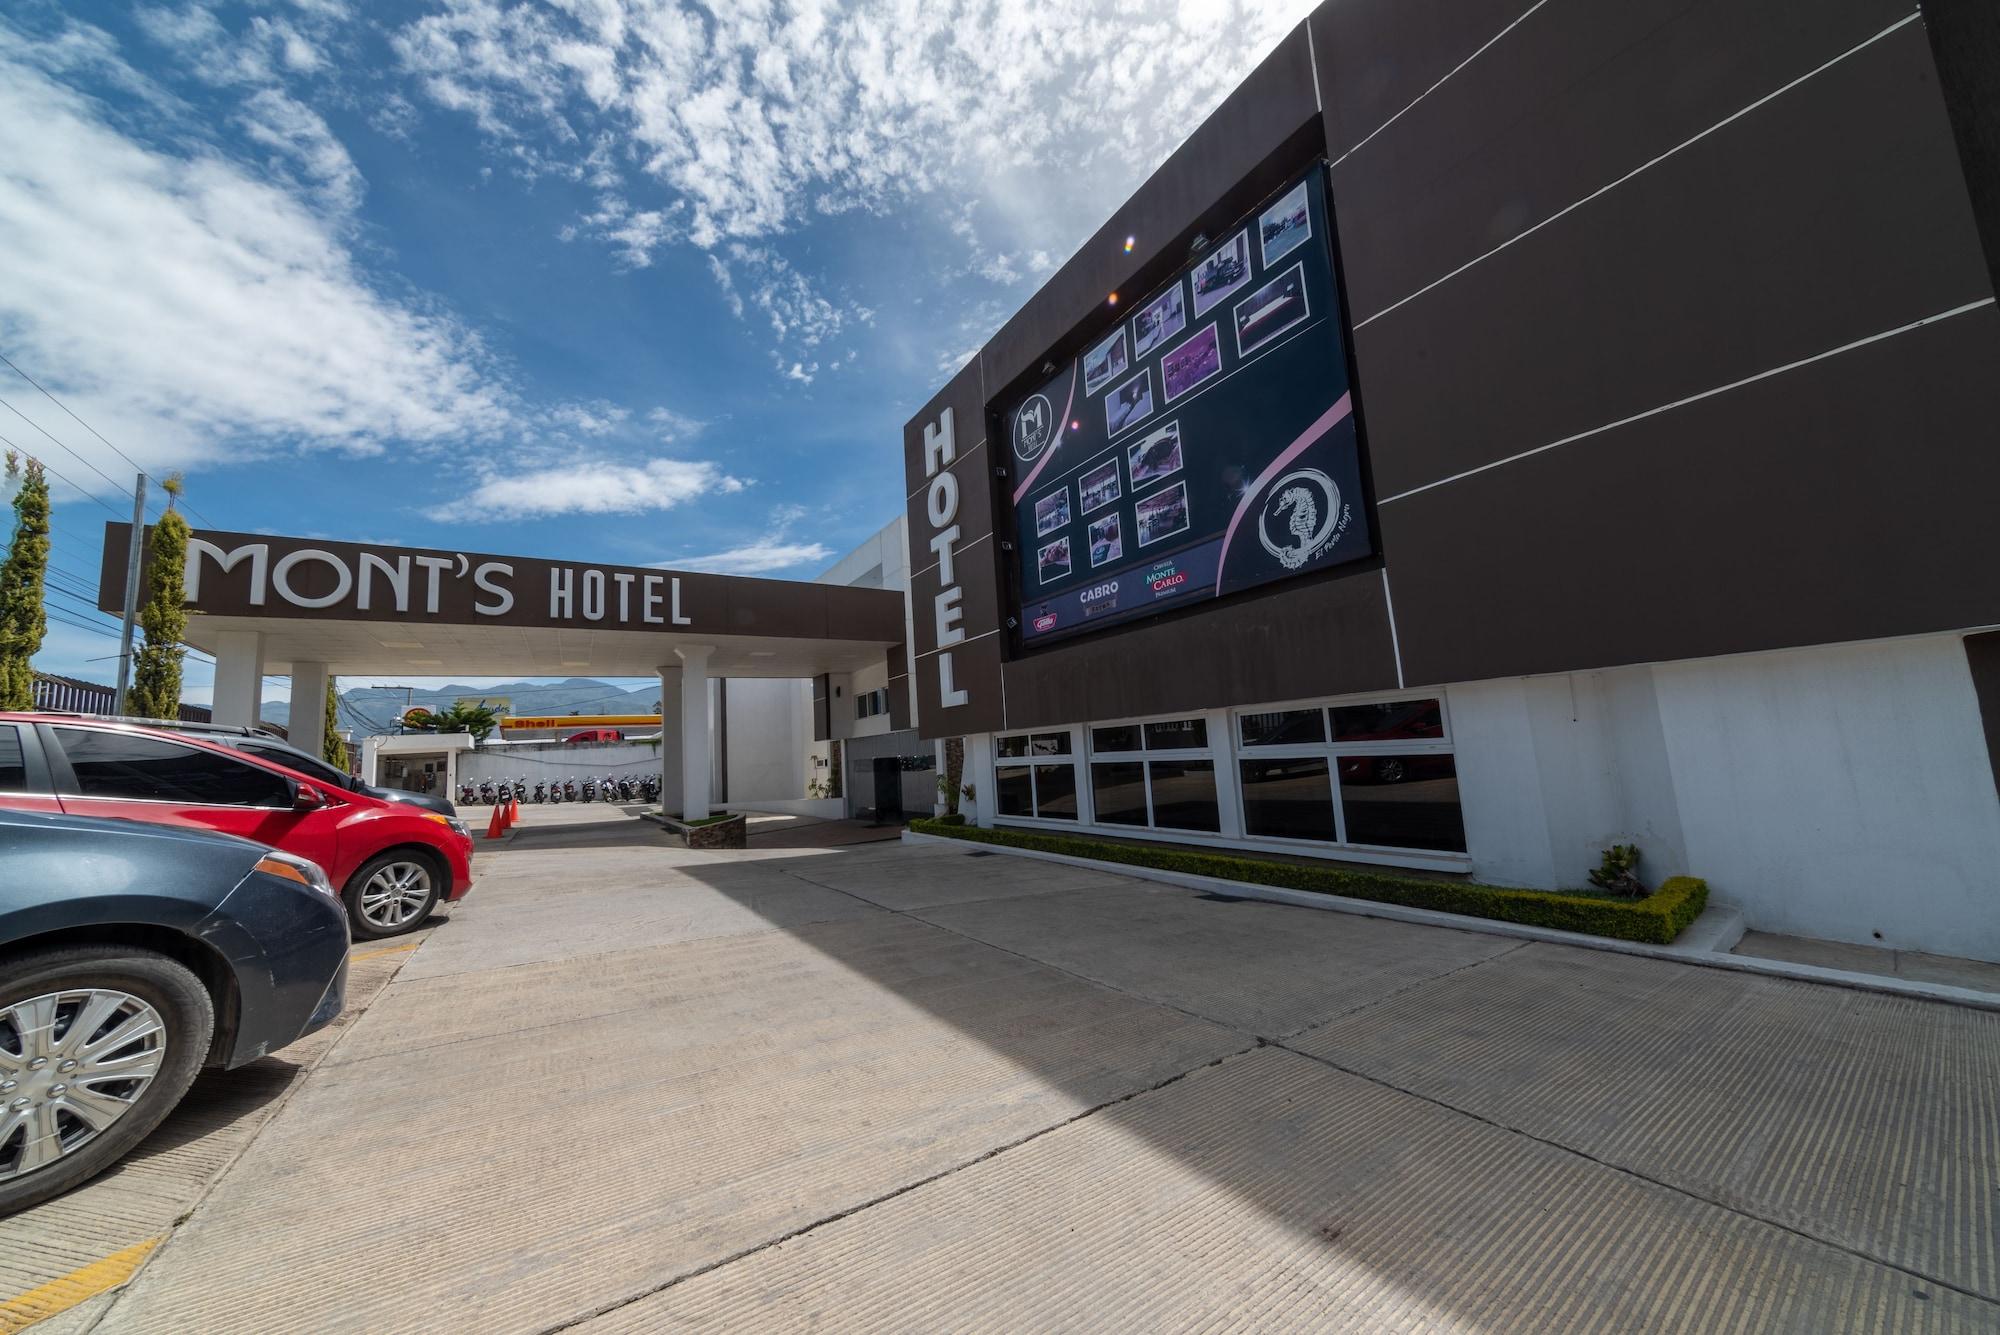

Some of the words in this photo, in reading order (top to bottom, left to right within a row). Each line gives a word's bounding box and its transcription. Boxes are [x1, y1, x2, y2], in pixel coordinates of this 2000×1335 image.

[923, 407, 969, 708] HOTEL
[184, 537, 515, 616] MONT'S
[550, 567, 692, 626] HOTEL
[1146, 567, 1176, 585] MONTE
[1080, 581, 1119, 604] CABRO
[514, 719, 555, 729] Shell
